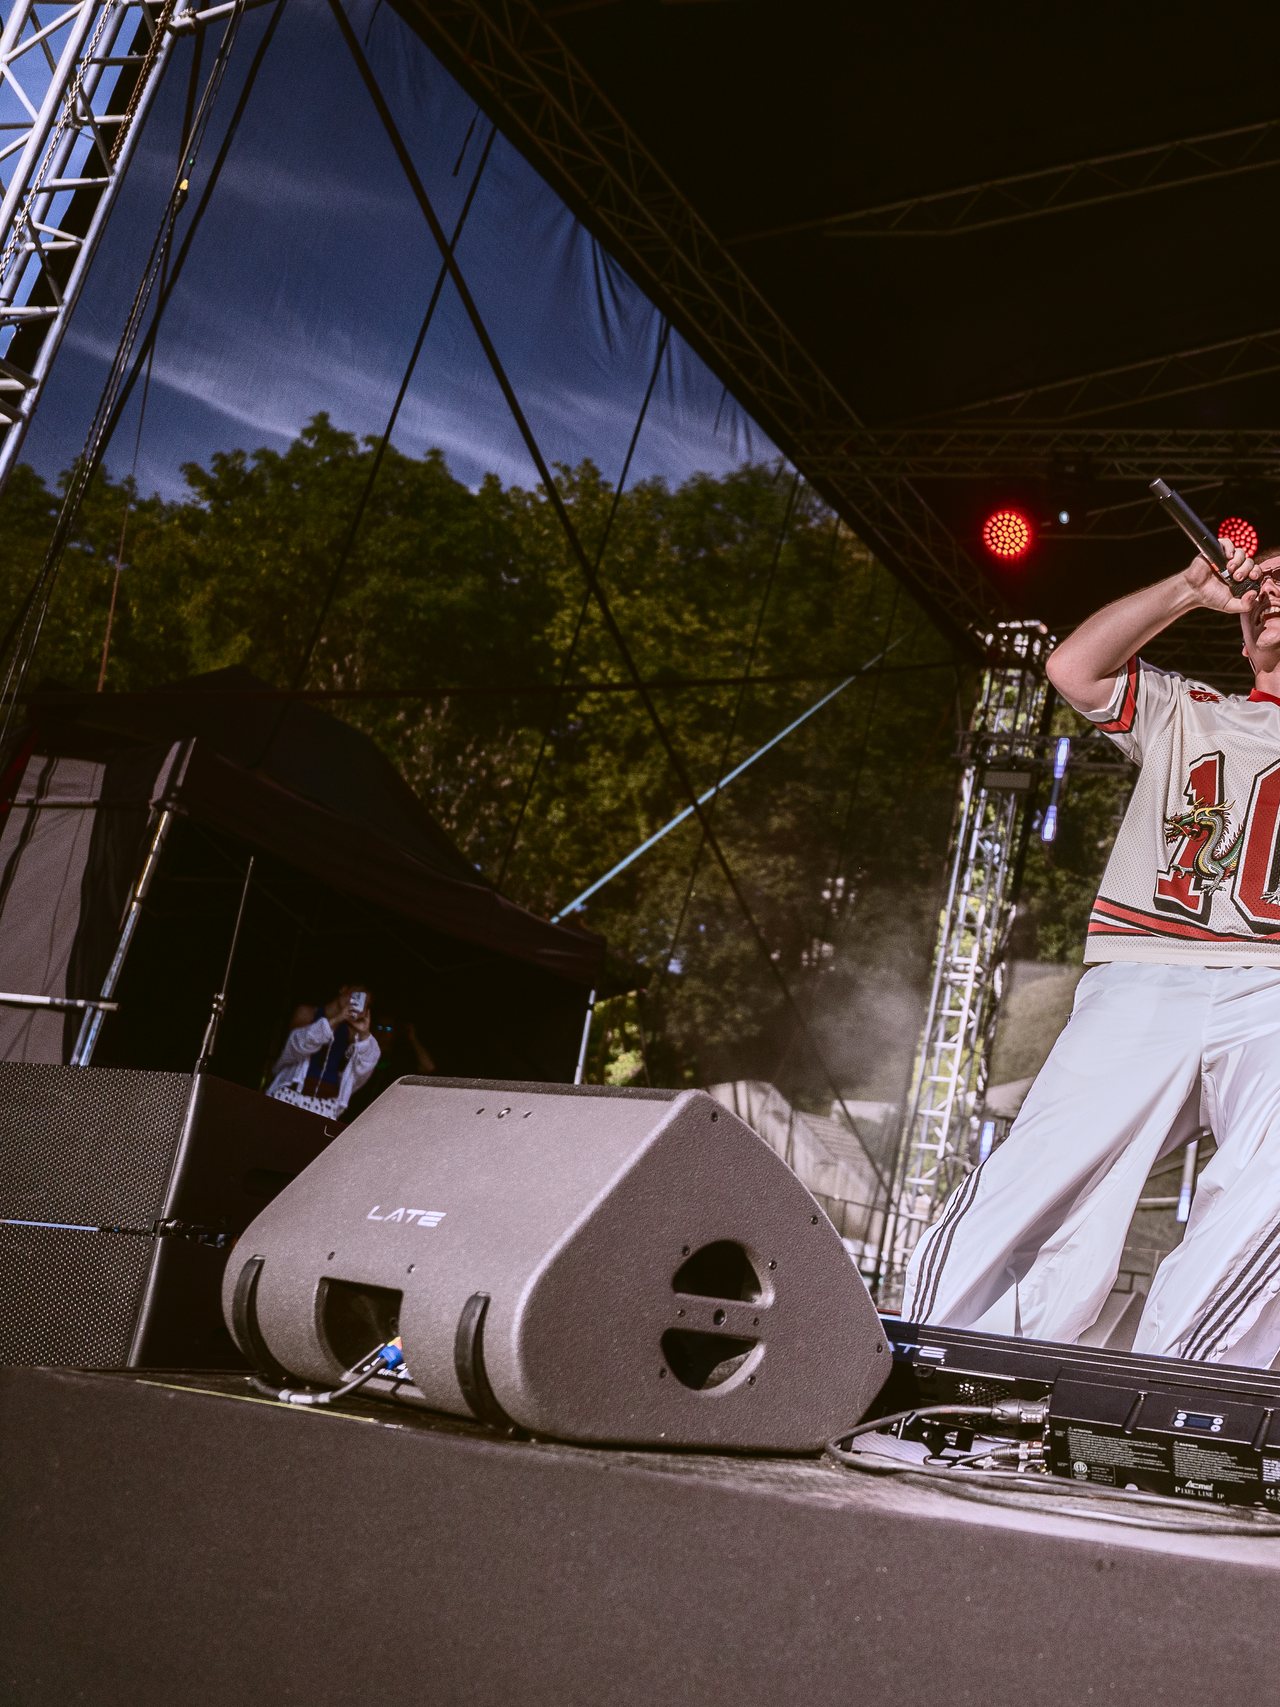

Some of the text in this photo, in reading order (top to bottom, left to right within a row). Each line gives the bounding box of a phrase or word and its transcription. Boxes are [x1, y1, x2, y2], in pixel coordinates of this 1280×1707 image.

[366, 1205, 447, 1228] LATE
[1175, 1486, 1196, 1496] PIXEL
[1198, 1490, 1214, 1498] LINE
